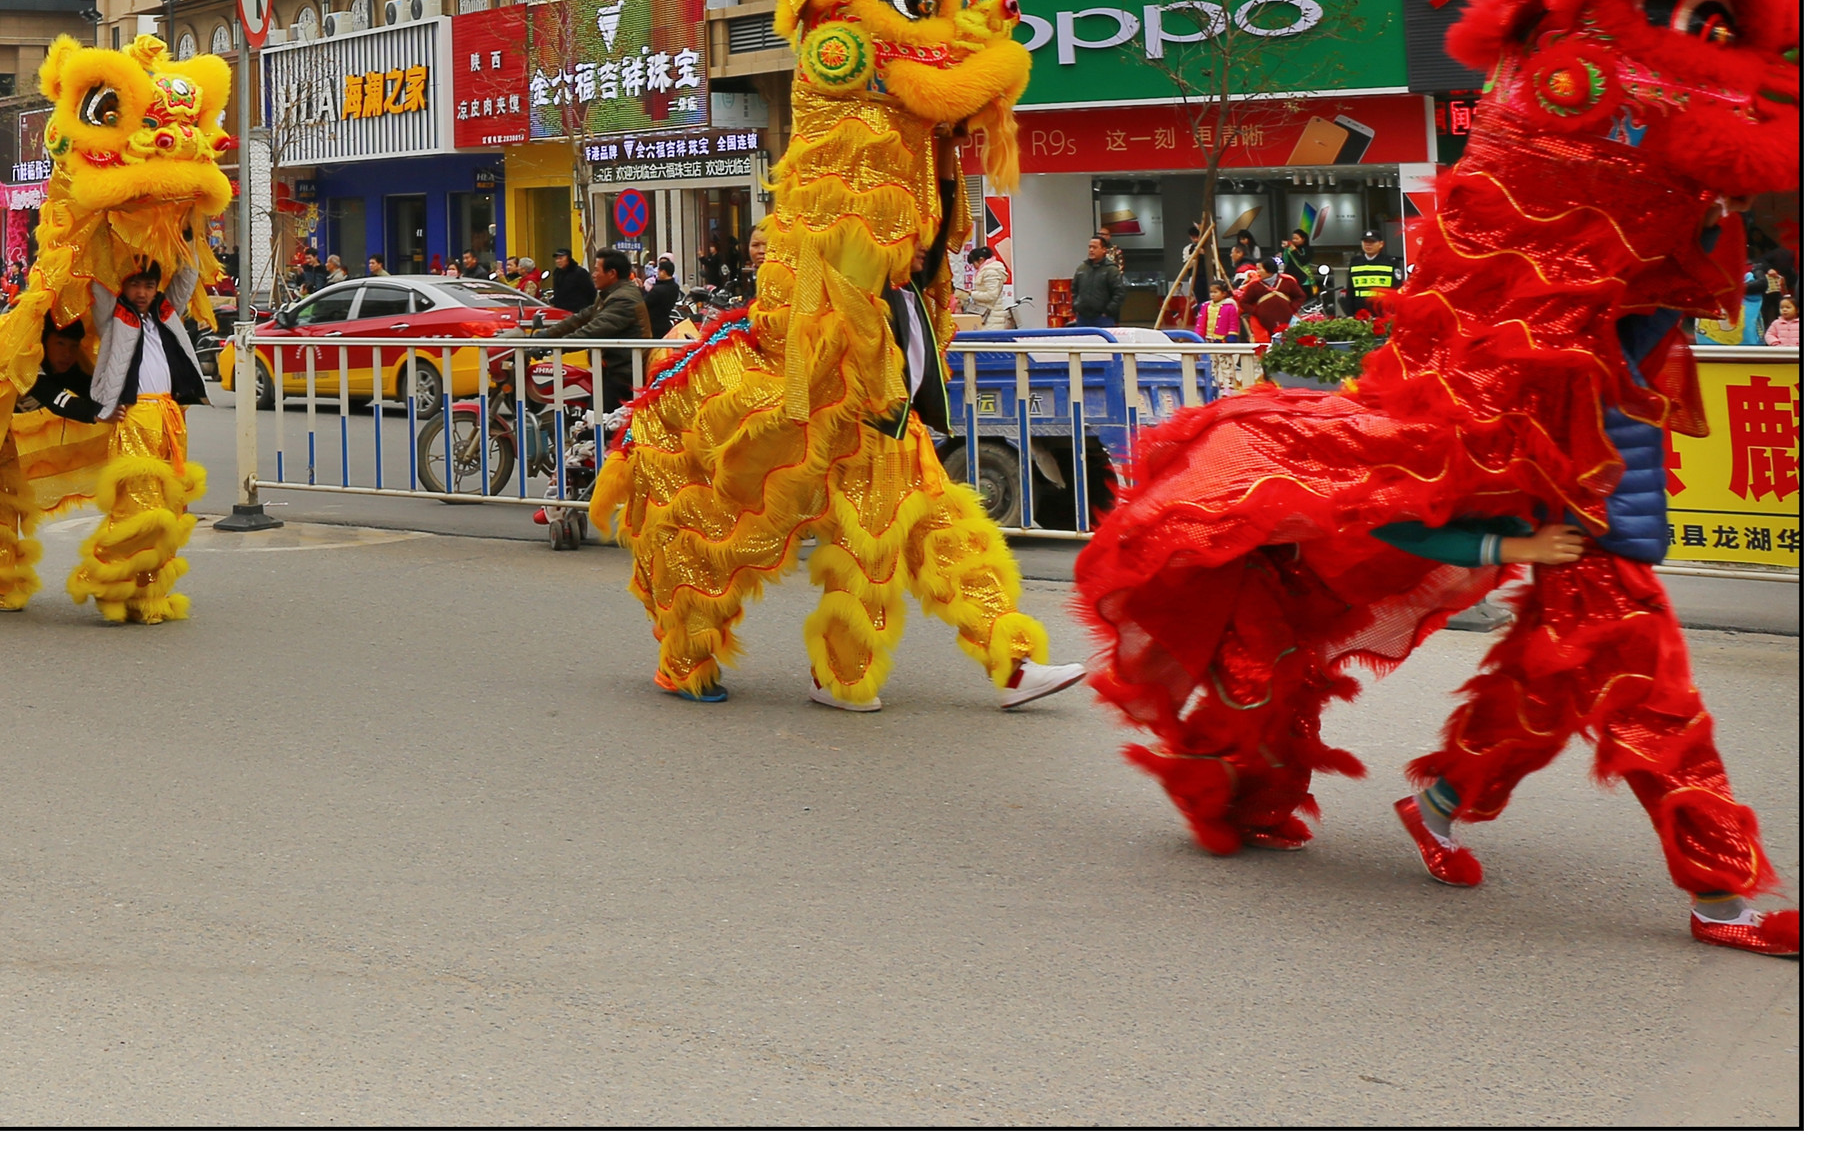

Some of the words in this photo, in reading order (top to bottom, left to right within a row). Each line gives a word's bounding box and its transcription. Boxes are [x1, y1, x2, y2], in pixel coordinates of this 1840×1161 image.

[470, 50, 501, 71] 陕西
[529, 46, 701, 108] 金六福吉祥珠宝
[341, 64, 428, 121] 海澜之家
[667, 96, 699, 111] 二分店
[635, 136, 709, 160] 金六福吉祥珠宝
[716, 132, 758, 152] 全国连锁
[1032, 130, 1077, 156] R9s
[1106, 126, 1176, 151] 这一刻
[616, 161, 702, 180] 欢迎光临金六福珠宝店
